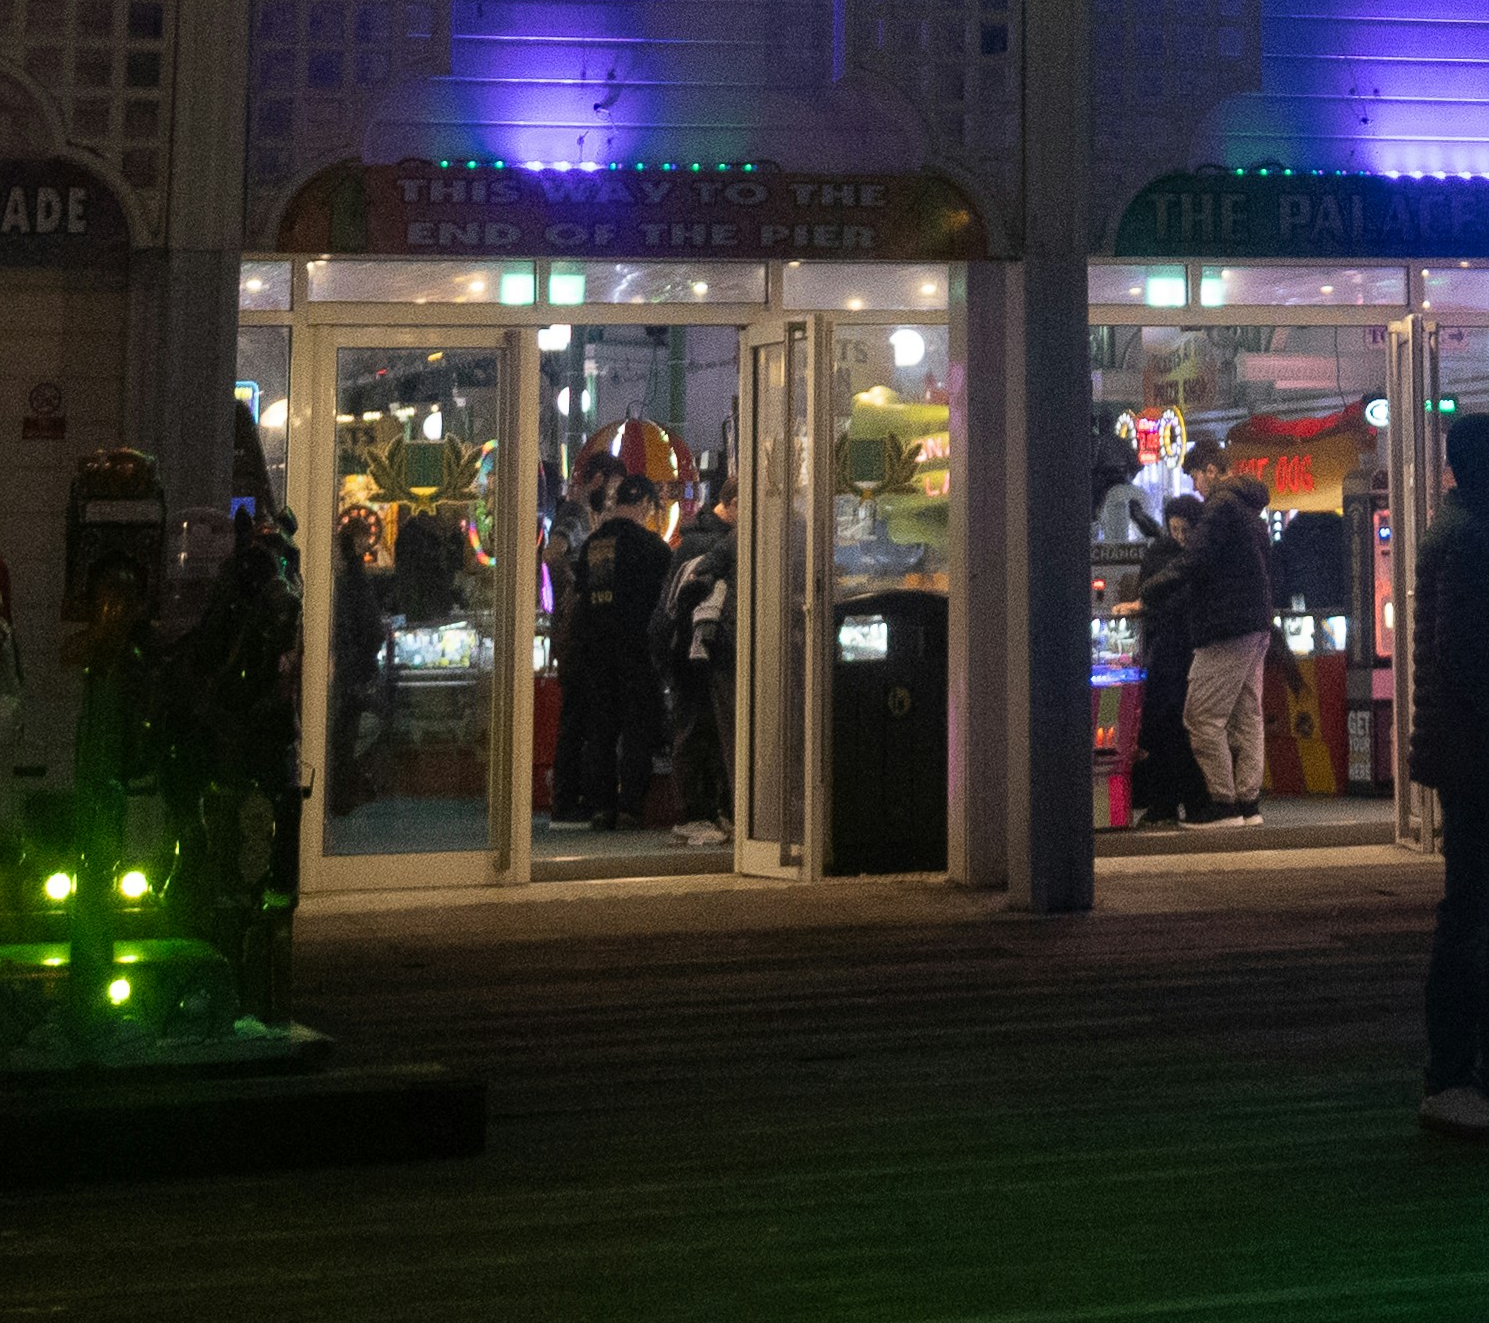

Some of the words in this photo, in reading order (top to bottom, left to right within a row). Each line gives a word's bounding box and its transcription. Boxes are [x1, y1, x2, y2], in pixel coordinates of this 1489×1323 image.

[395, 177, 522, 205] THIS
[539, 177, 672, 206] WAY
[693, 180, 769, 207] TO
[789, 181, 887, 209] THE
[1148, 192, 1248, 243] THE
[1277, 192, 1479, 243] PALACE
[405, 221, 522, 248] END
[544, 221, 619, 249] OF
[637, 222, 740, 249] THE
[759, 223, 877, 250] PIER
